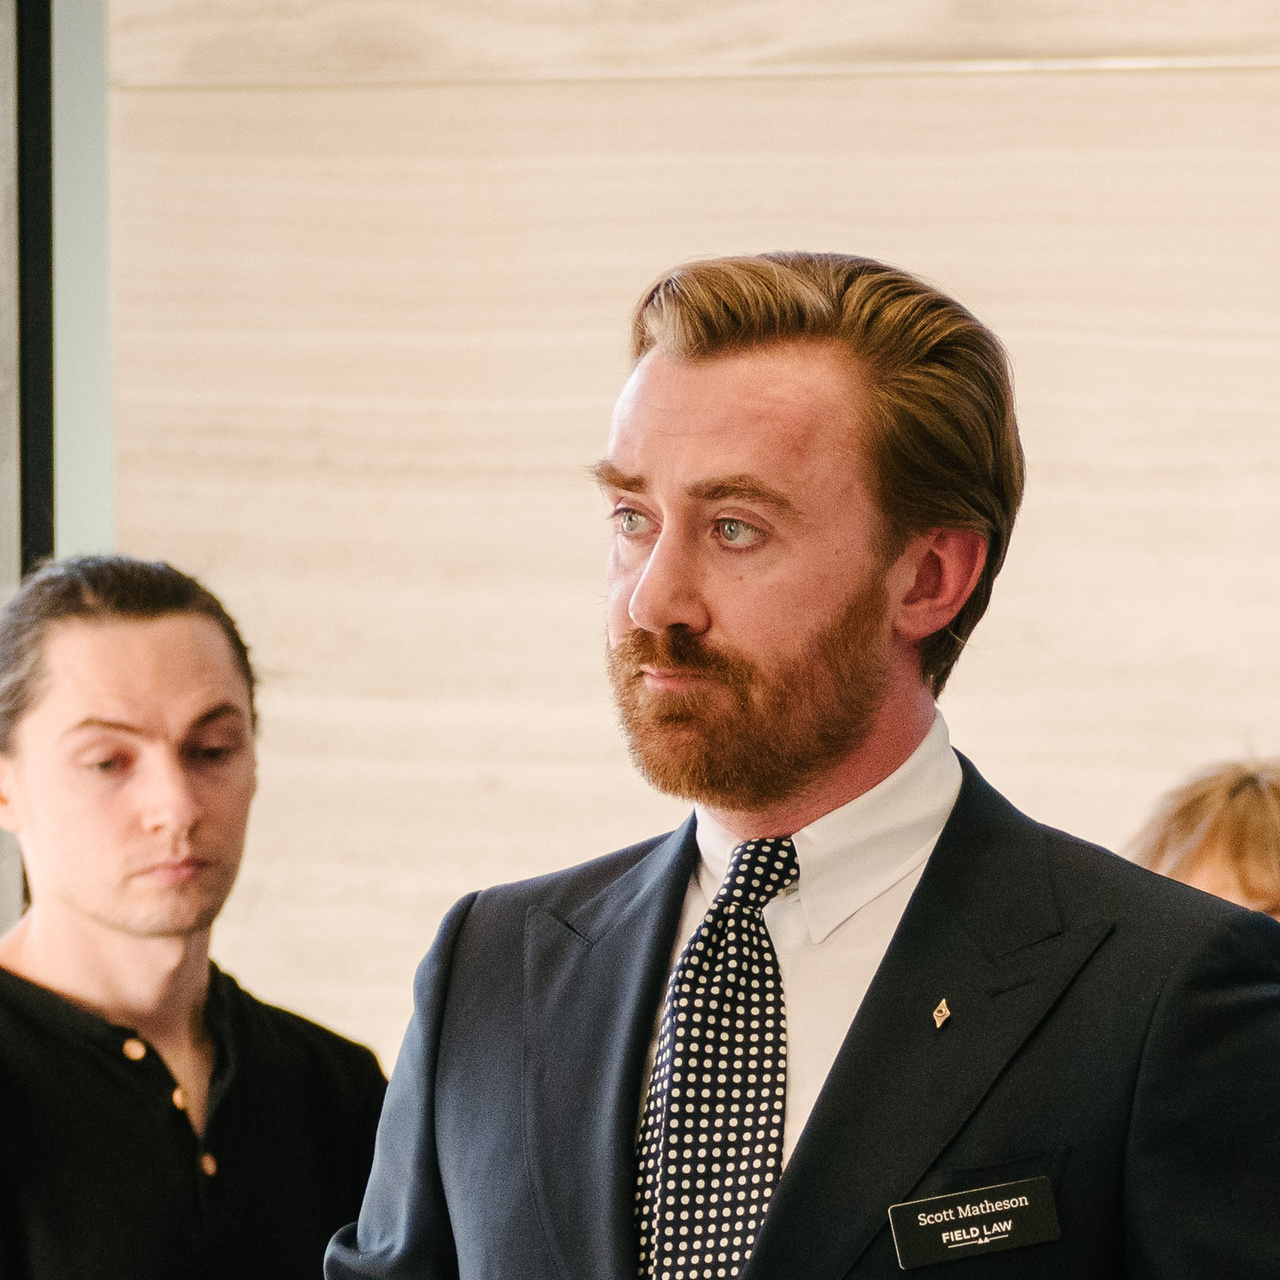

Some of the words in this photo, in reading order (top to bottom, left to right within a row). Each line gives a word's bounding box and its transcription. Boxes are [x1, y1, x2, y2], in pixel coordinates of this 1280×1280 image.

[917, 1208, 955, 1226] Scott
[957, 1196, 1029, 1219] Matheson
[941, 1227, 980, 1244] FIELD
[983, 1220, 1013, 1236] LAW
